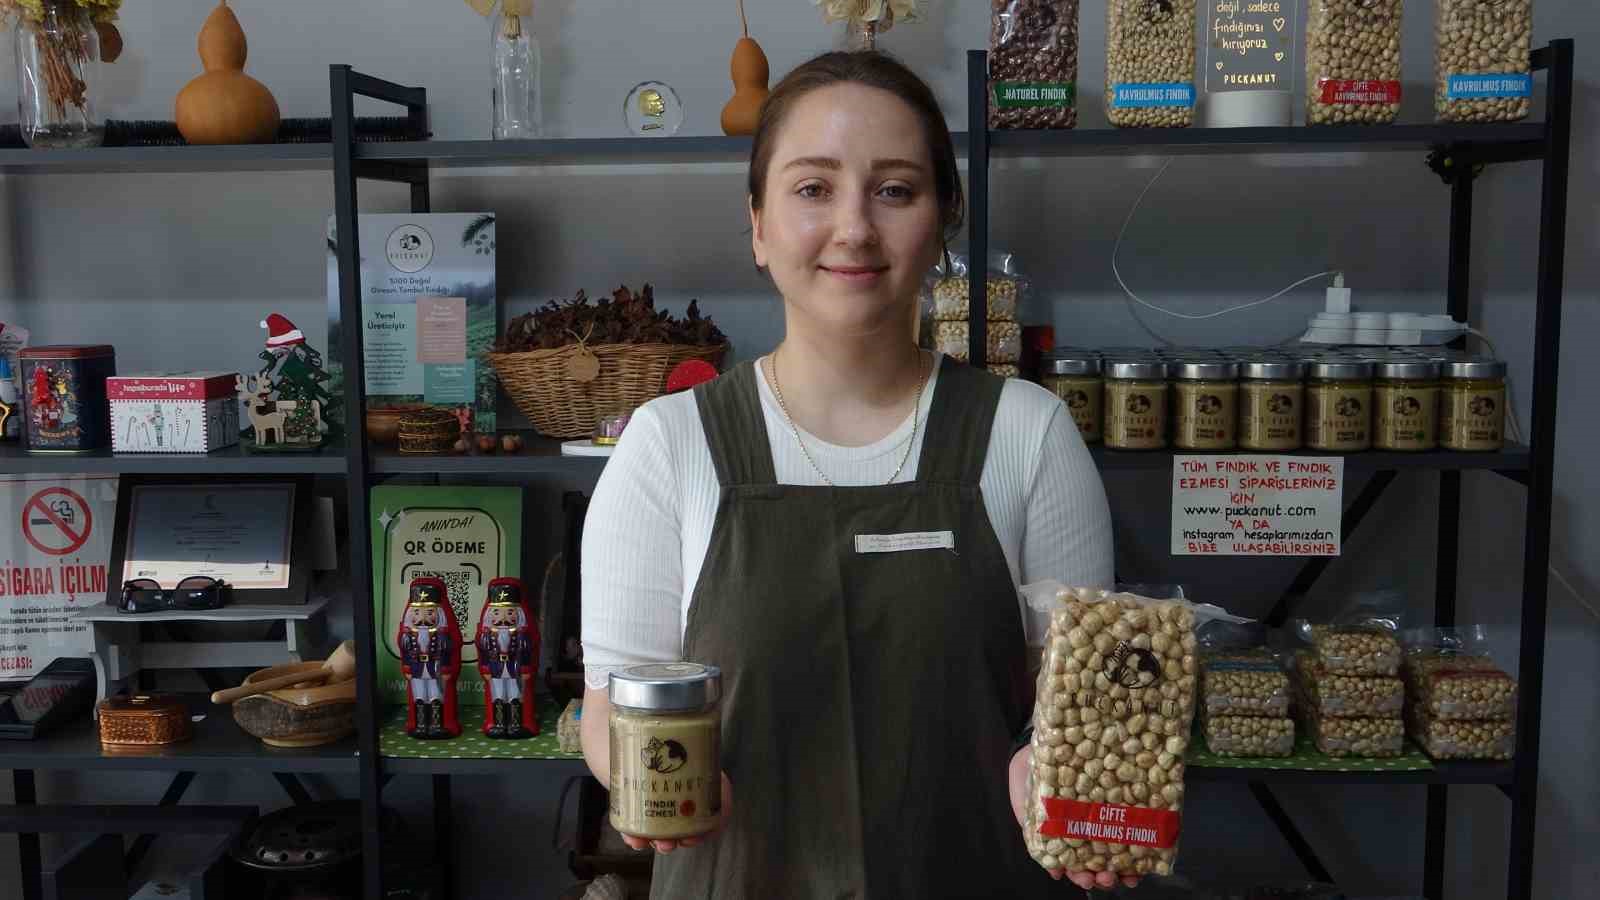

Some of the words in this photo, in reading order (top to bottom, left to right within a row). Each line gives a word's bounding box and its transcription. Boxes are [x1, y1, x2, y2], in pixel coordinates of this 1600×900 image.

[1223, 73, 1276, 84] PUCKANUT
[1005, 88, 1039, 100] NATUREL
[1040, 88, 1067, 100] FINDIK
[1181, 461, 1208, 473] TÜM
[1216, 461, 1259, 473] FINDIK
[1265, 462, 1281, 473] VE
[1288, 462, 1333, 474] FINDIK
[1183, 503, 1317, 521] www.puckanut.com
[420, 515, 475, 533] ANINDA!
[1229, 518, 1245, 530] YA
[1252, 518, 1271, 530] DA
[1183, 528, 1235, 543] instagram
[403, 540, 426, 556] QR
[431, 536, 486, 554] ÖDEME
[59, 557, 107, 602] İÇİLM
[644, 799, 676, 808] FINDIK
[1126, 826, 1158, 843] FINDIK
